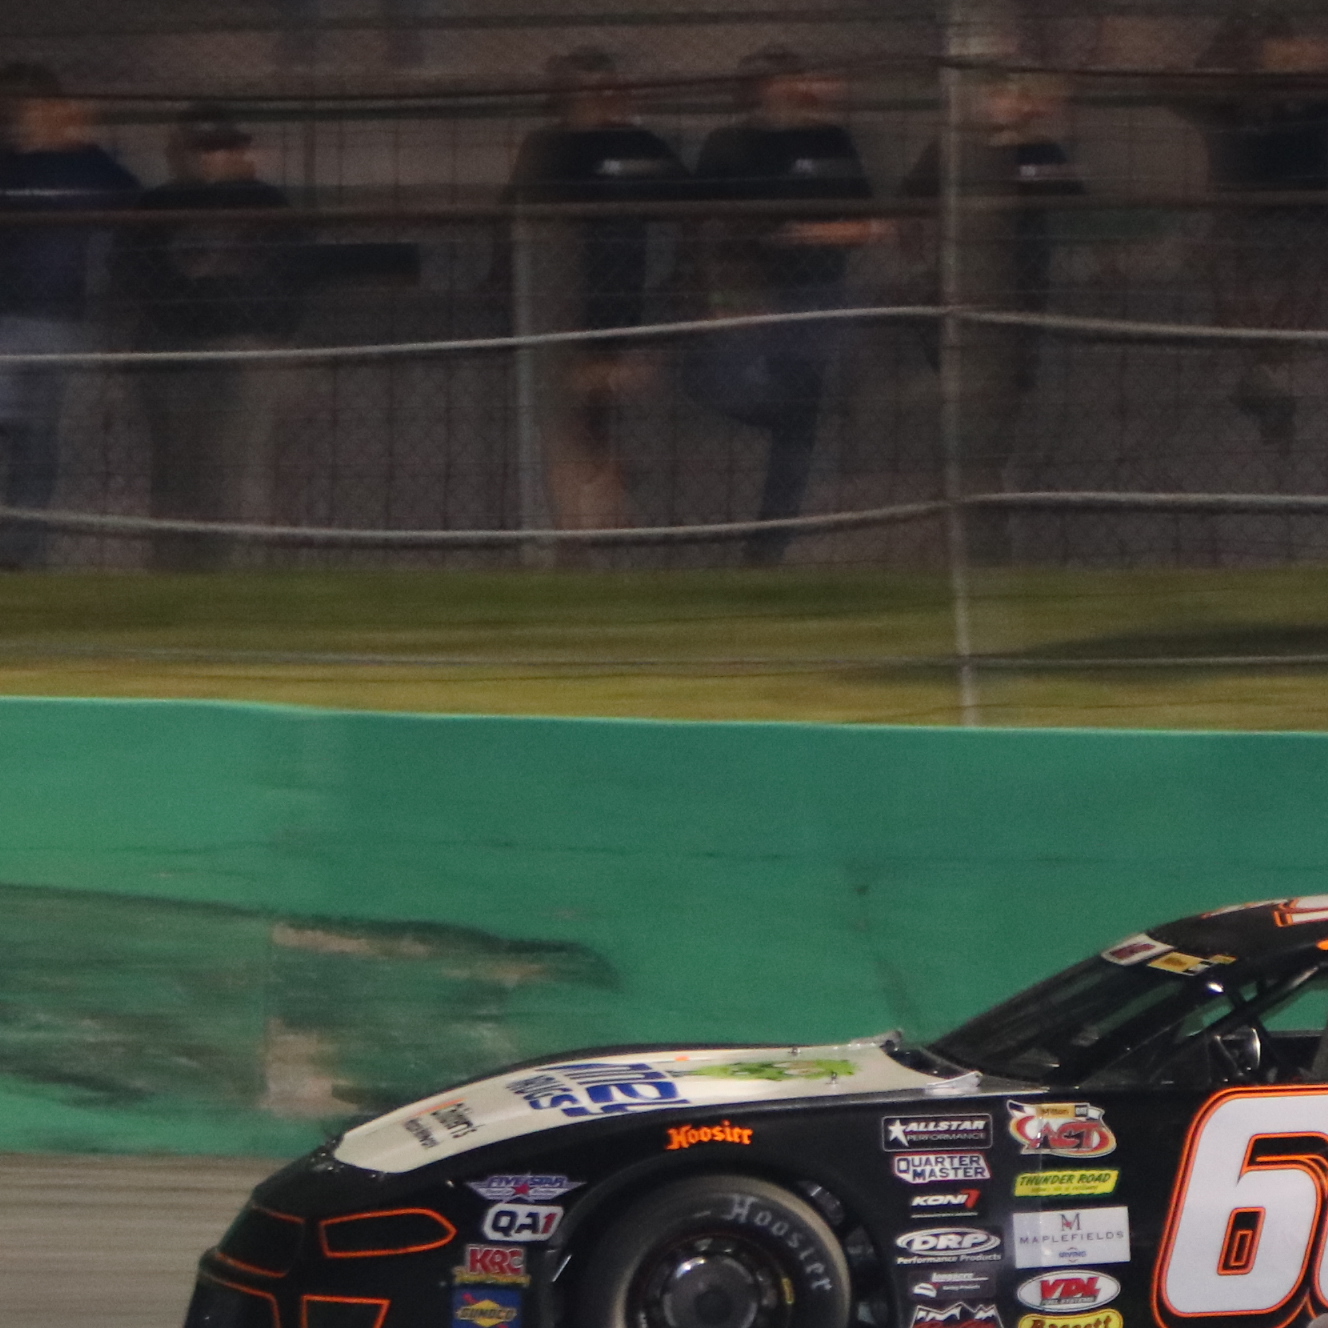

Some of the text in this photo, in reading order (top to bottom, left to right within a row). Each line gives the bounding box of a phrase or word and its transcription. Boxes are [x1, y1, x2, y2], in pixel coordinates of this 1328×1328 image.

[905, 1120, 987, 1132] ALLSTAR
[666, 1119, 754, 1150] Hoosier
[906, 1132, 985, 1141] PERFORMANCE
[1029, 1120, 1101, 1149] ACT
[897, 1155, 981, 1174] QUARTER
[912, 1167, 986, 1181] MASTER
[1020, 1172, 1111, 1186] THUNDER ROAD
[911, 1194, 969, 1207] KONI
[491, 1208, 558, 1237] QA1
[723, 1195, 832, 1292] Hoosier
[911, 1233, 989, 1251] DRP
[1020, 1230, 1124, 1244] MAPLEFIELDS
[468, 1248, 524, 1276] KRC
[897, 1253, 1002, 1265] Performance Products
[1041, 1276, 1101, 1300] VDL
[459, 1307, 517, 1320] SUNOCO
